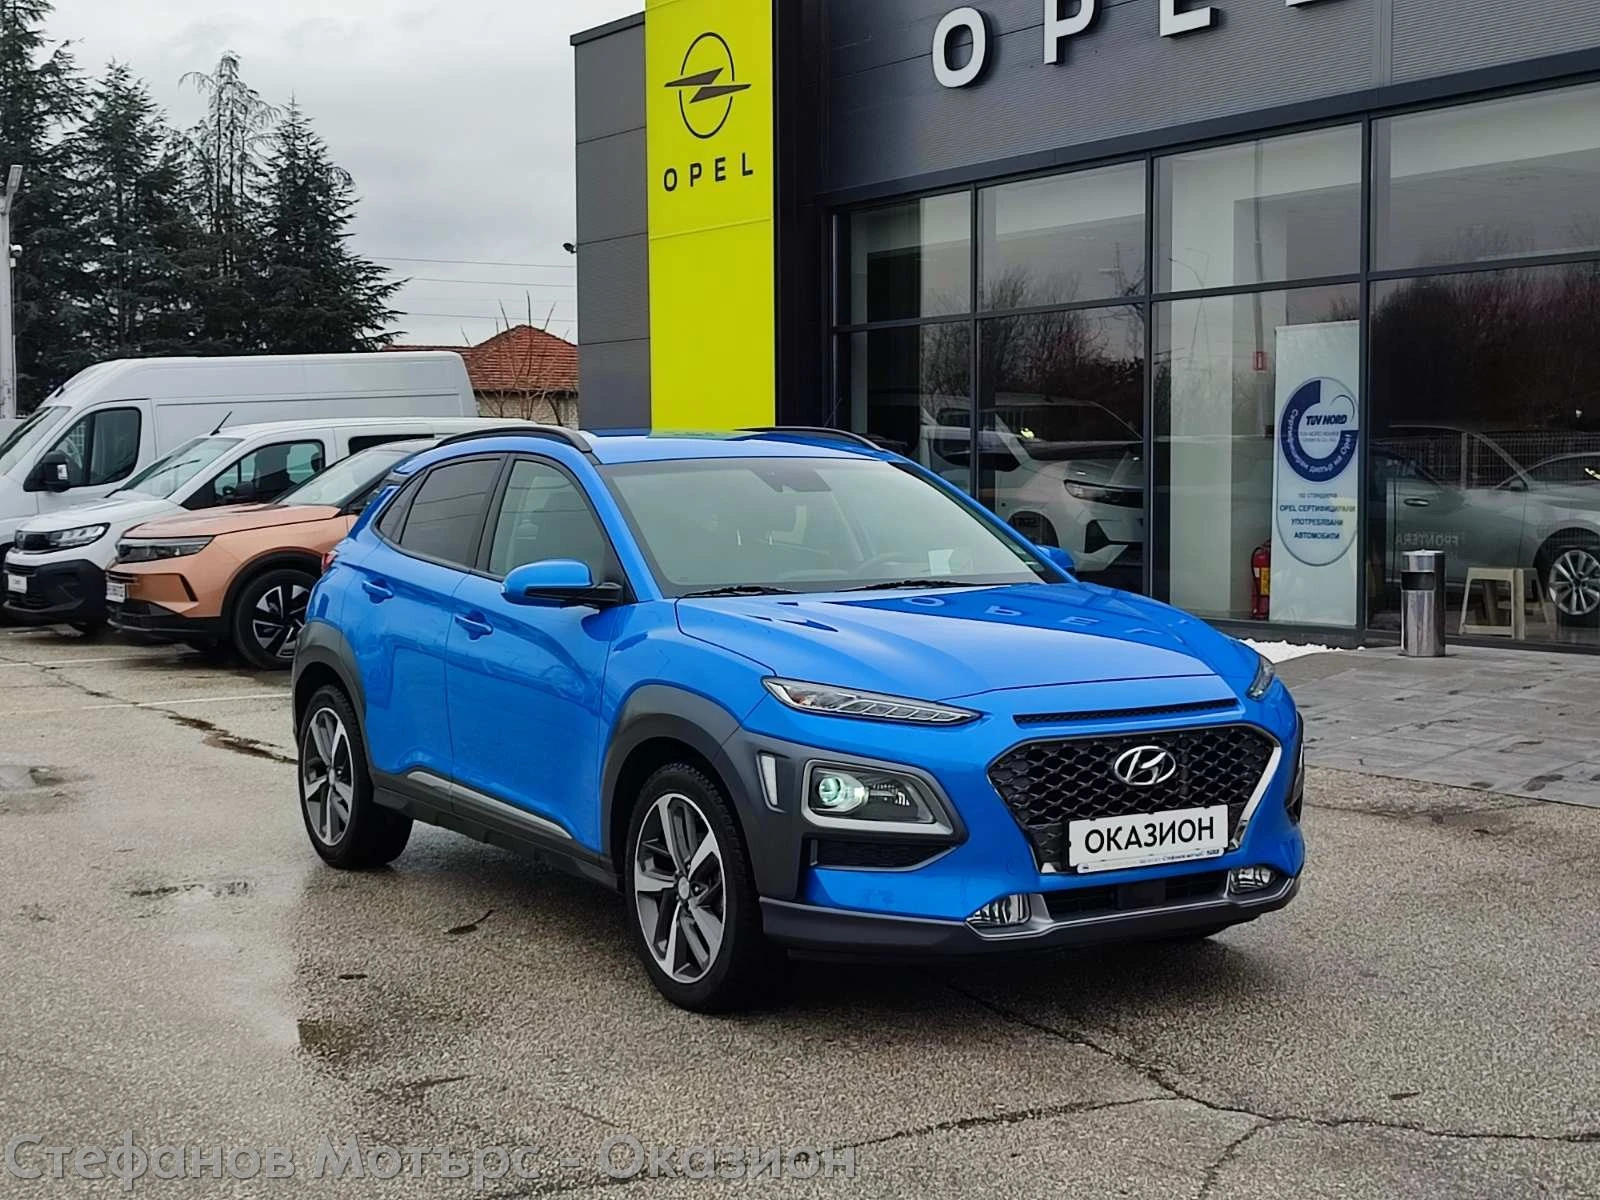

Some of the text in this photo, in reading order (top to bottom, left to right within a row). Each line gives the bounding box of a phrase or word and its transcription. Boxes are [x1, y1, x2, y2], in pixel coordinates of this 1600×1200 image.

[663, 152, 753, 192] OPEL
[1323, 414, 1348, 425] NORD
[1340, 434, 1353, 456] Opel
[1279, 504, 1297, 512] OPEL
[1084, 816, 1214, 854] ОКАЗИОН
